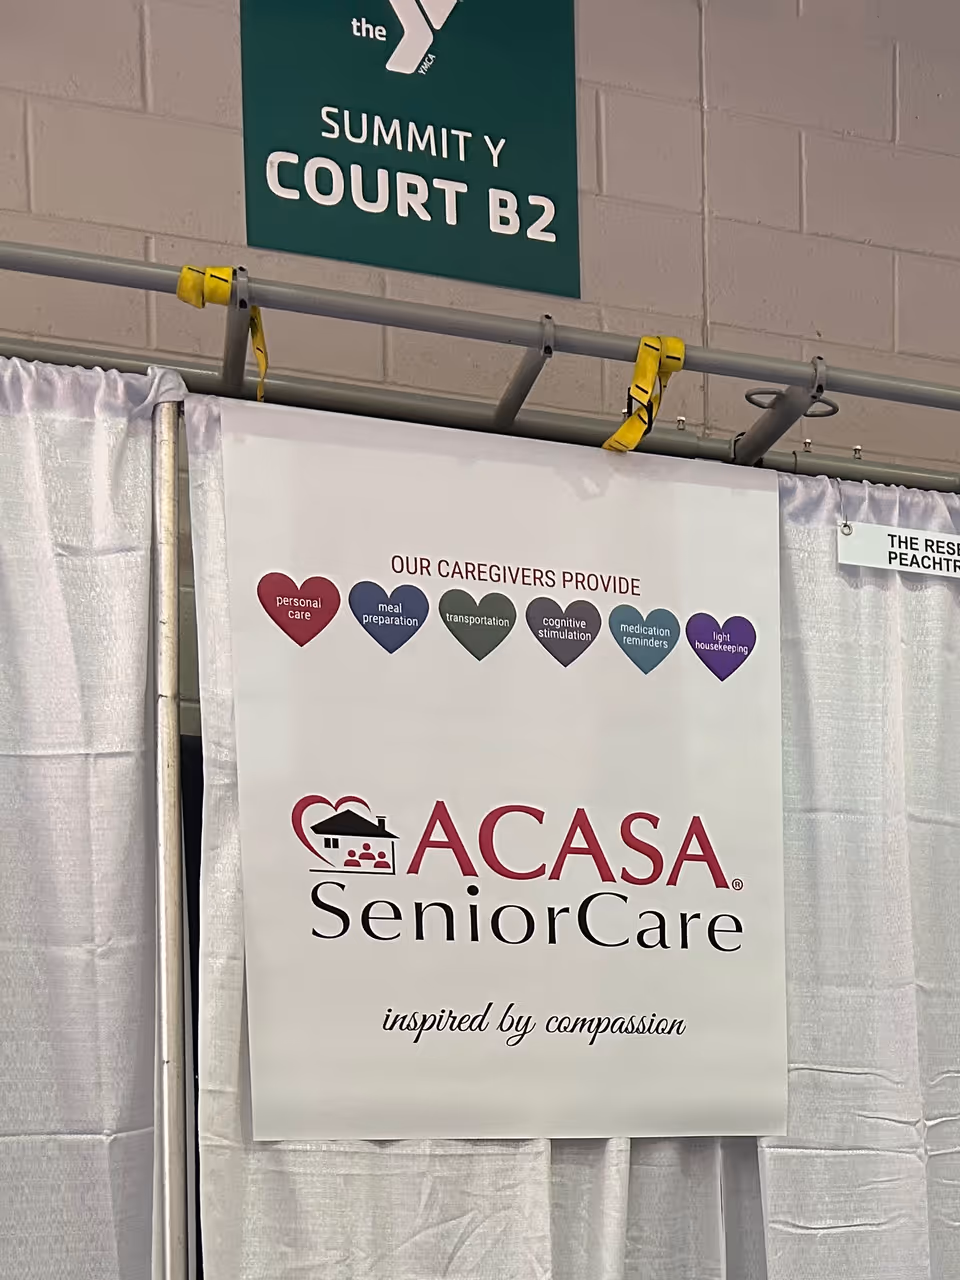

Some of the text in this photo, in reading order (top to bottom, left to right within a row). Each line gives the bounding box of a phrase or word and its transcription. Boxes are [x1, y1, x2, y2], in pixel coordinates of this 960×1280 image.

[351, 17, 387, 41] the
[417, 53, 437, 76] YMCA
[320, 105, 507, 168] SUMMIT Y
[265, 150, 557, 243] COURT B2
[887, 533, 919, 551] THE
[390, 554, 641, 596] OUR CAREGIVERS PROVIDE
[275, 595, 322, 609] personal
[378, 602, 402, 614] meal
[287, 609, 311, 620] care
[362, 613, 419, 627] preparation
[446, 612, 510, 627] transportation
[542, 616, 586, 630] cognitive
[620, 622, 671, 637] medication
[538, 628, 592, 641] stimulation
[623, 634, 669, 649] reminders
[712, 631, 731, 644] light
[695, 640, 748, 655] housekeeping
[309, 880, 744, 952] SeniorCare
[381, 1002, 688, 1047] inspired by compassion
